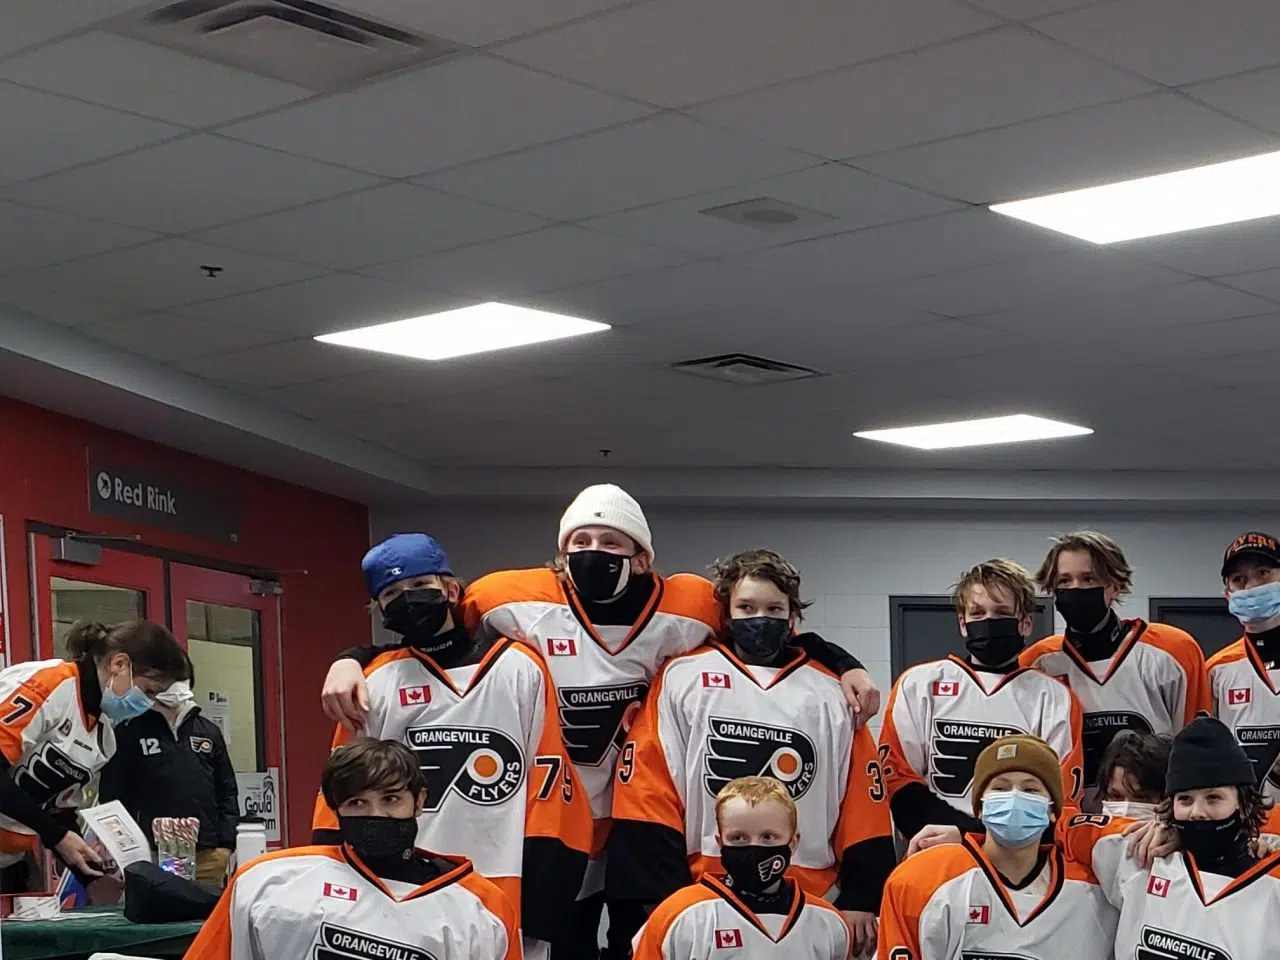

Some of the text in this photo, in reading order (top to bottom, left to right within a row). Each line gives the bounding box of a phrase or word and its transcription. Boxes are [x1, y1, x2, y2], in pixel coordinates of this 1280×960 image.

[115, 477, 176, 515] Red Rink
[570, 687, 639, 704] ORANGEVILLE
[1, 695, 34, 725] 7
[1085, 716, 1129, 727] NGEVILLE
[415, 730, 490, 744] ORANGEVILLE
[719, 723, 793, 744] ORANGEVILLE
[943, 725, 1012, 739] ORANGEVILLE
[140, 737, 162, 756] 12
[468, 760, 520, 801] FLYERS
[788, 761, 814, 796] YERS
[245, 797, 272, 814] Gould
